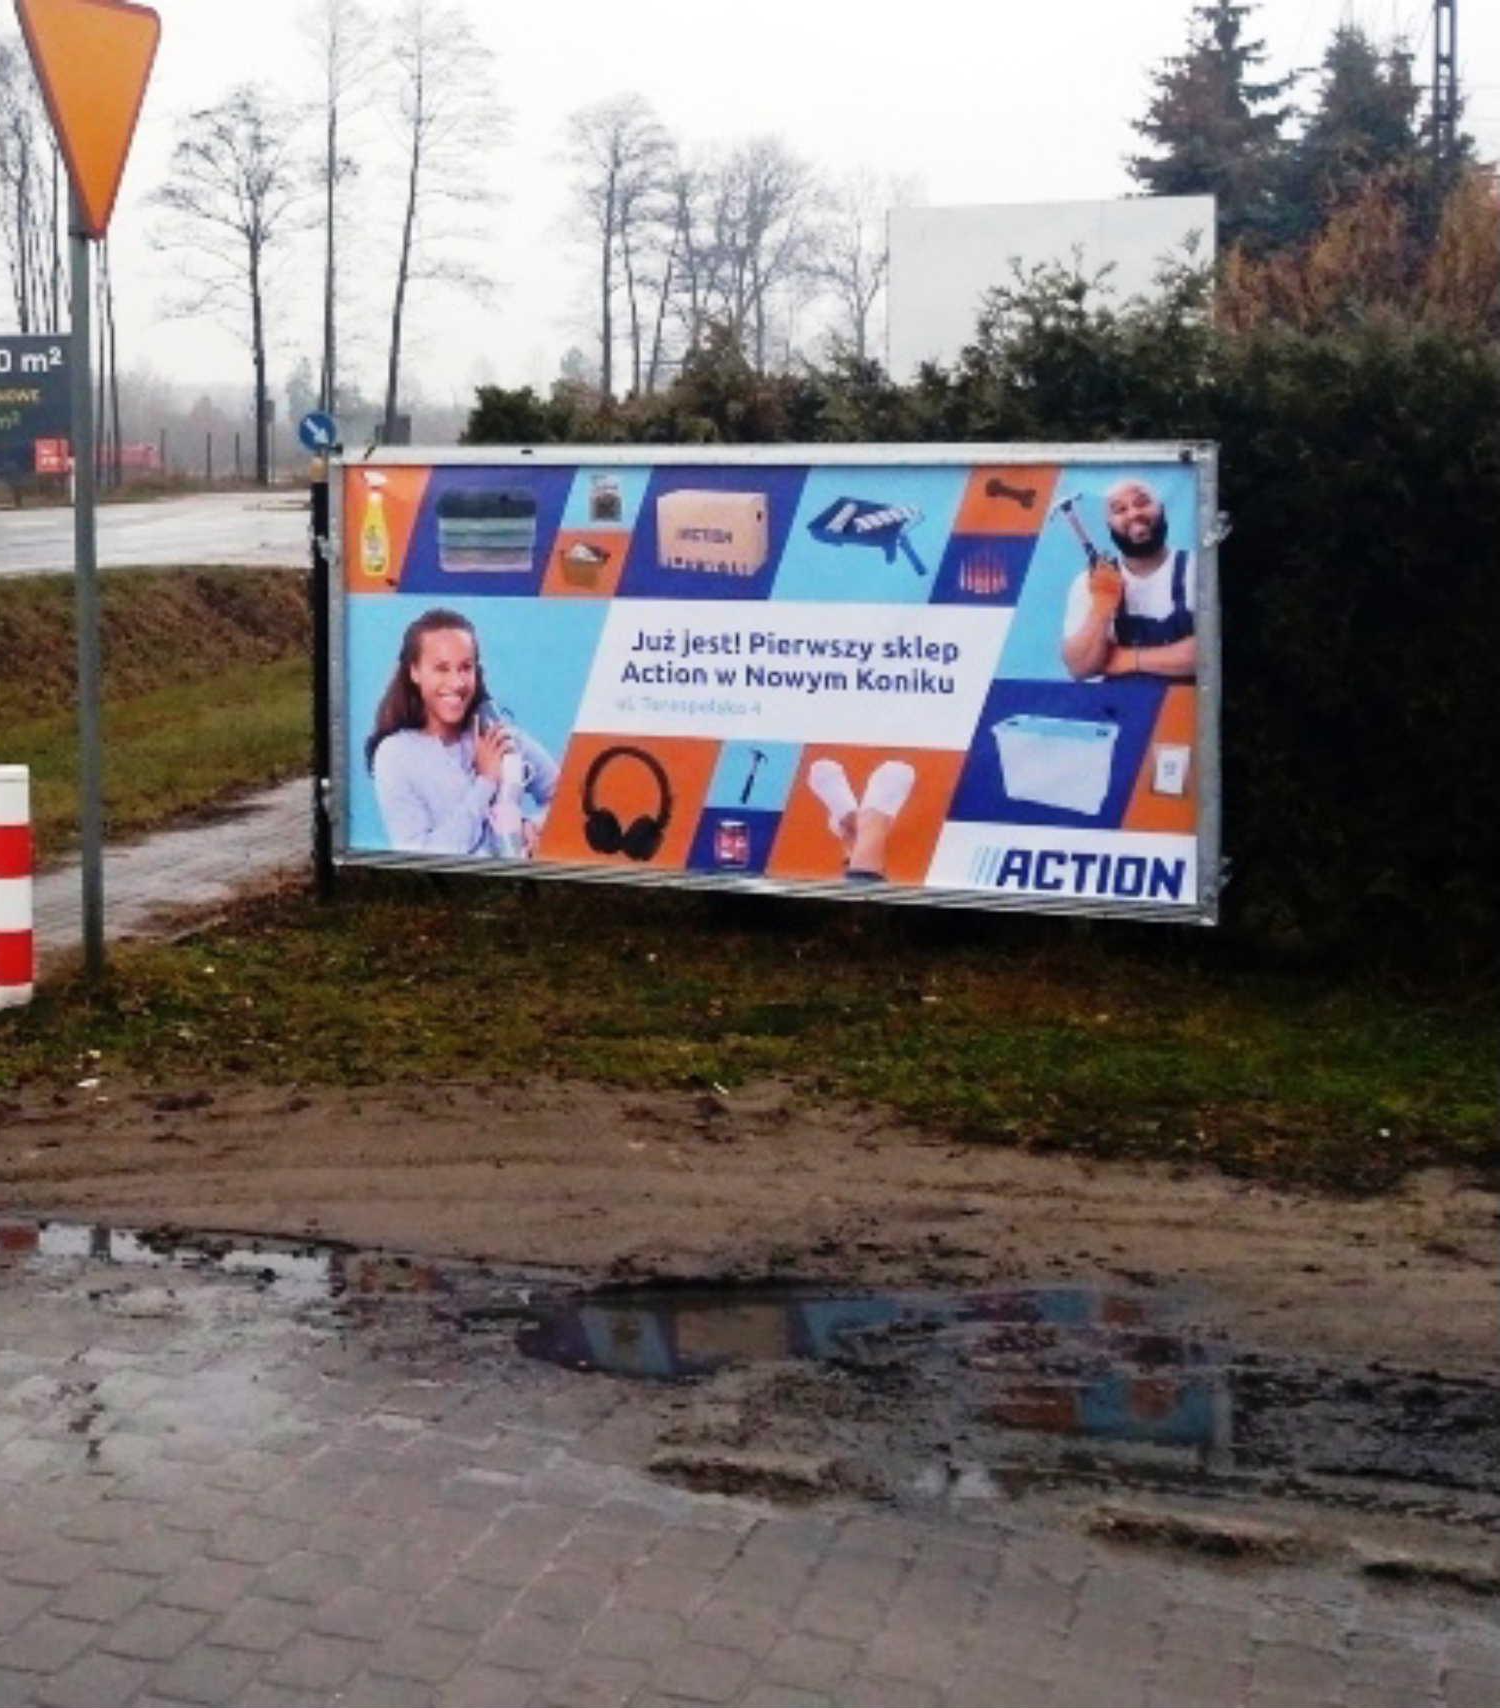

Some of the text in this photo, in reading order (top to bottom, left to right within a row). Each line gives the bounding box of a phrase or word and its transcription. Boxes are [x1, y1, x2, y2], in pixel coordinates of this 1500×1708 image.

[630, 629, 960, 664] Już jest! Pierwszy sklep
[620, 661, 956, 694] Action w Nowym Koniku
[996, 849, 1187, 901] ACTION
